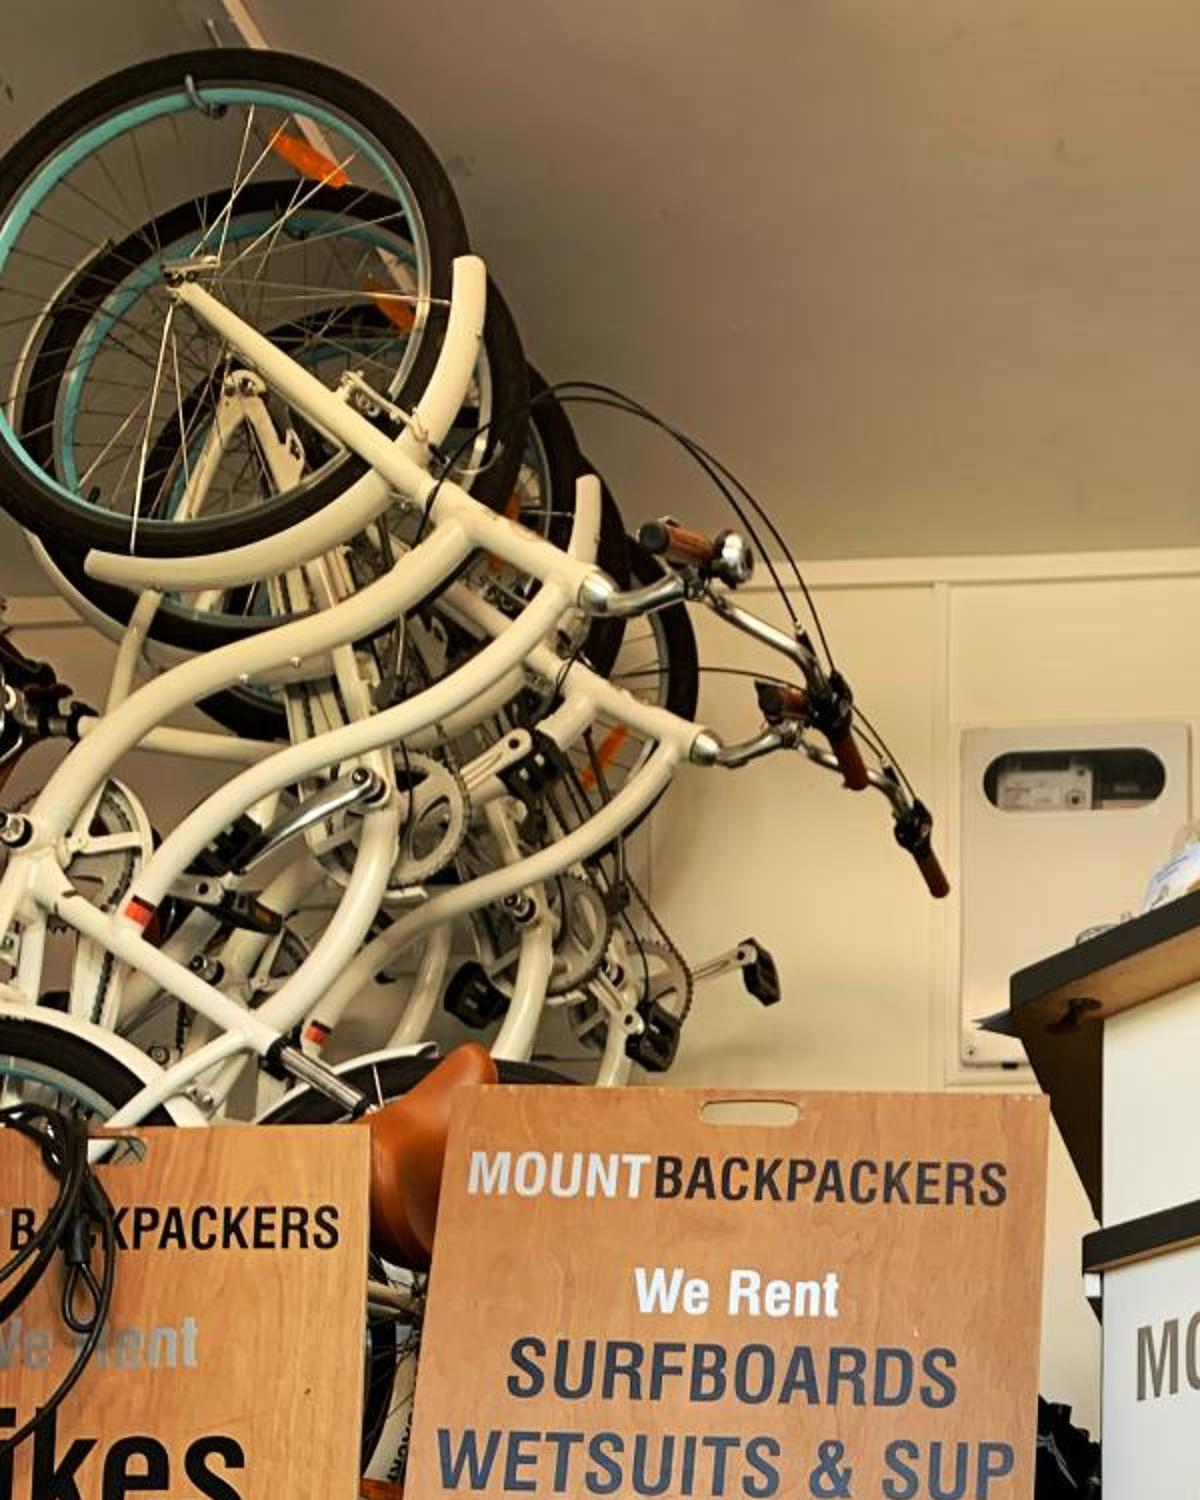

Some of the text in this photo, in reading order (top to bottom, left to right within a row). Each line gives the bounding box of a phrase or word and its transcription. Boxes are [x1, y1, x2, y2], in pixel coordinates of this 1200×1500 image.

[9, 1205, 339, 1250] BKPACKERS
[634, 1267, 840, 1317] We Rent
[506, 1337, 958, 1409] SURFBOARDS
[437, 1428, 781, 1499] WETSUITS
[808, 1438, 854, 1500] &
